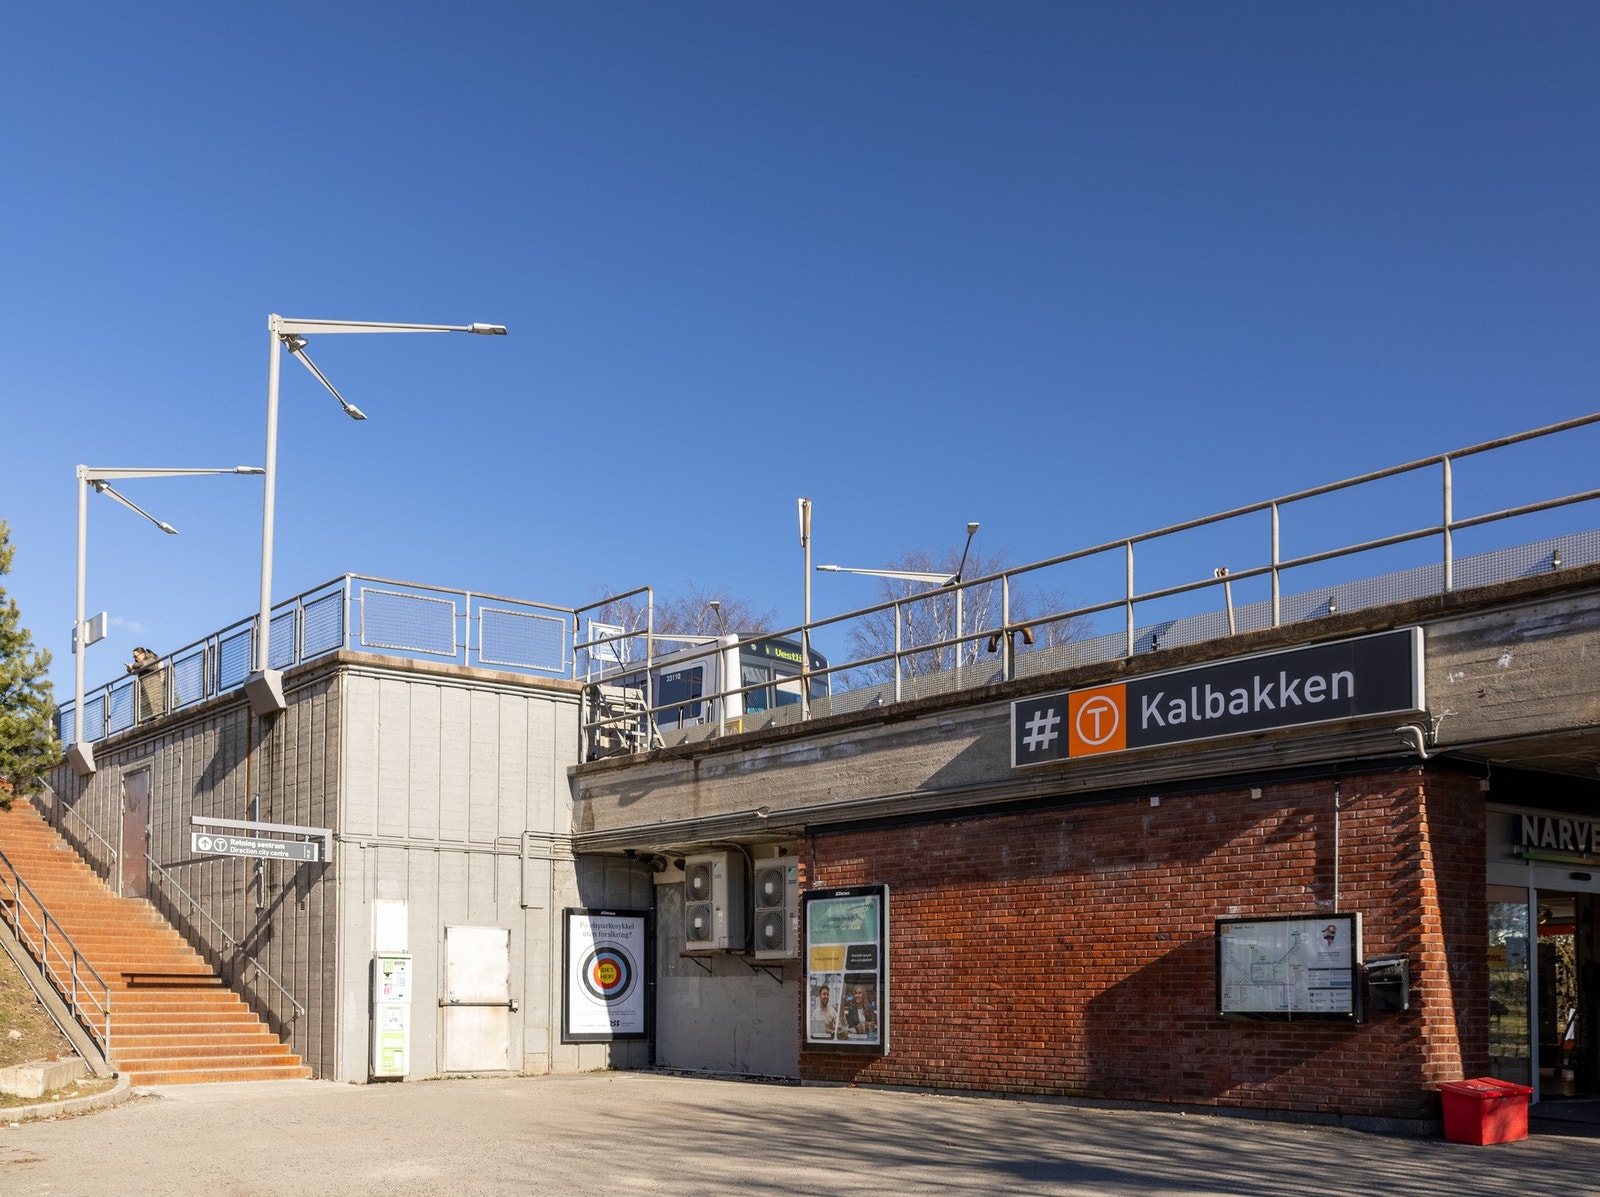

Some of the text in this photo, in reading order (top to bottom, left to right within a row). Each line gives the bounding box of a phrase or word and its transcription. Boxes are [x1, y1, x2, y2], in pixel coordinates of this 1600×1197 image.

[1141, 669, 1355, 730] Kalbakken
[230, 838, 285, 850] Retning sentrum
[230, 846, 257, 855] Direction
[258, 849, 270, 857] city
